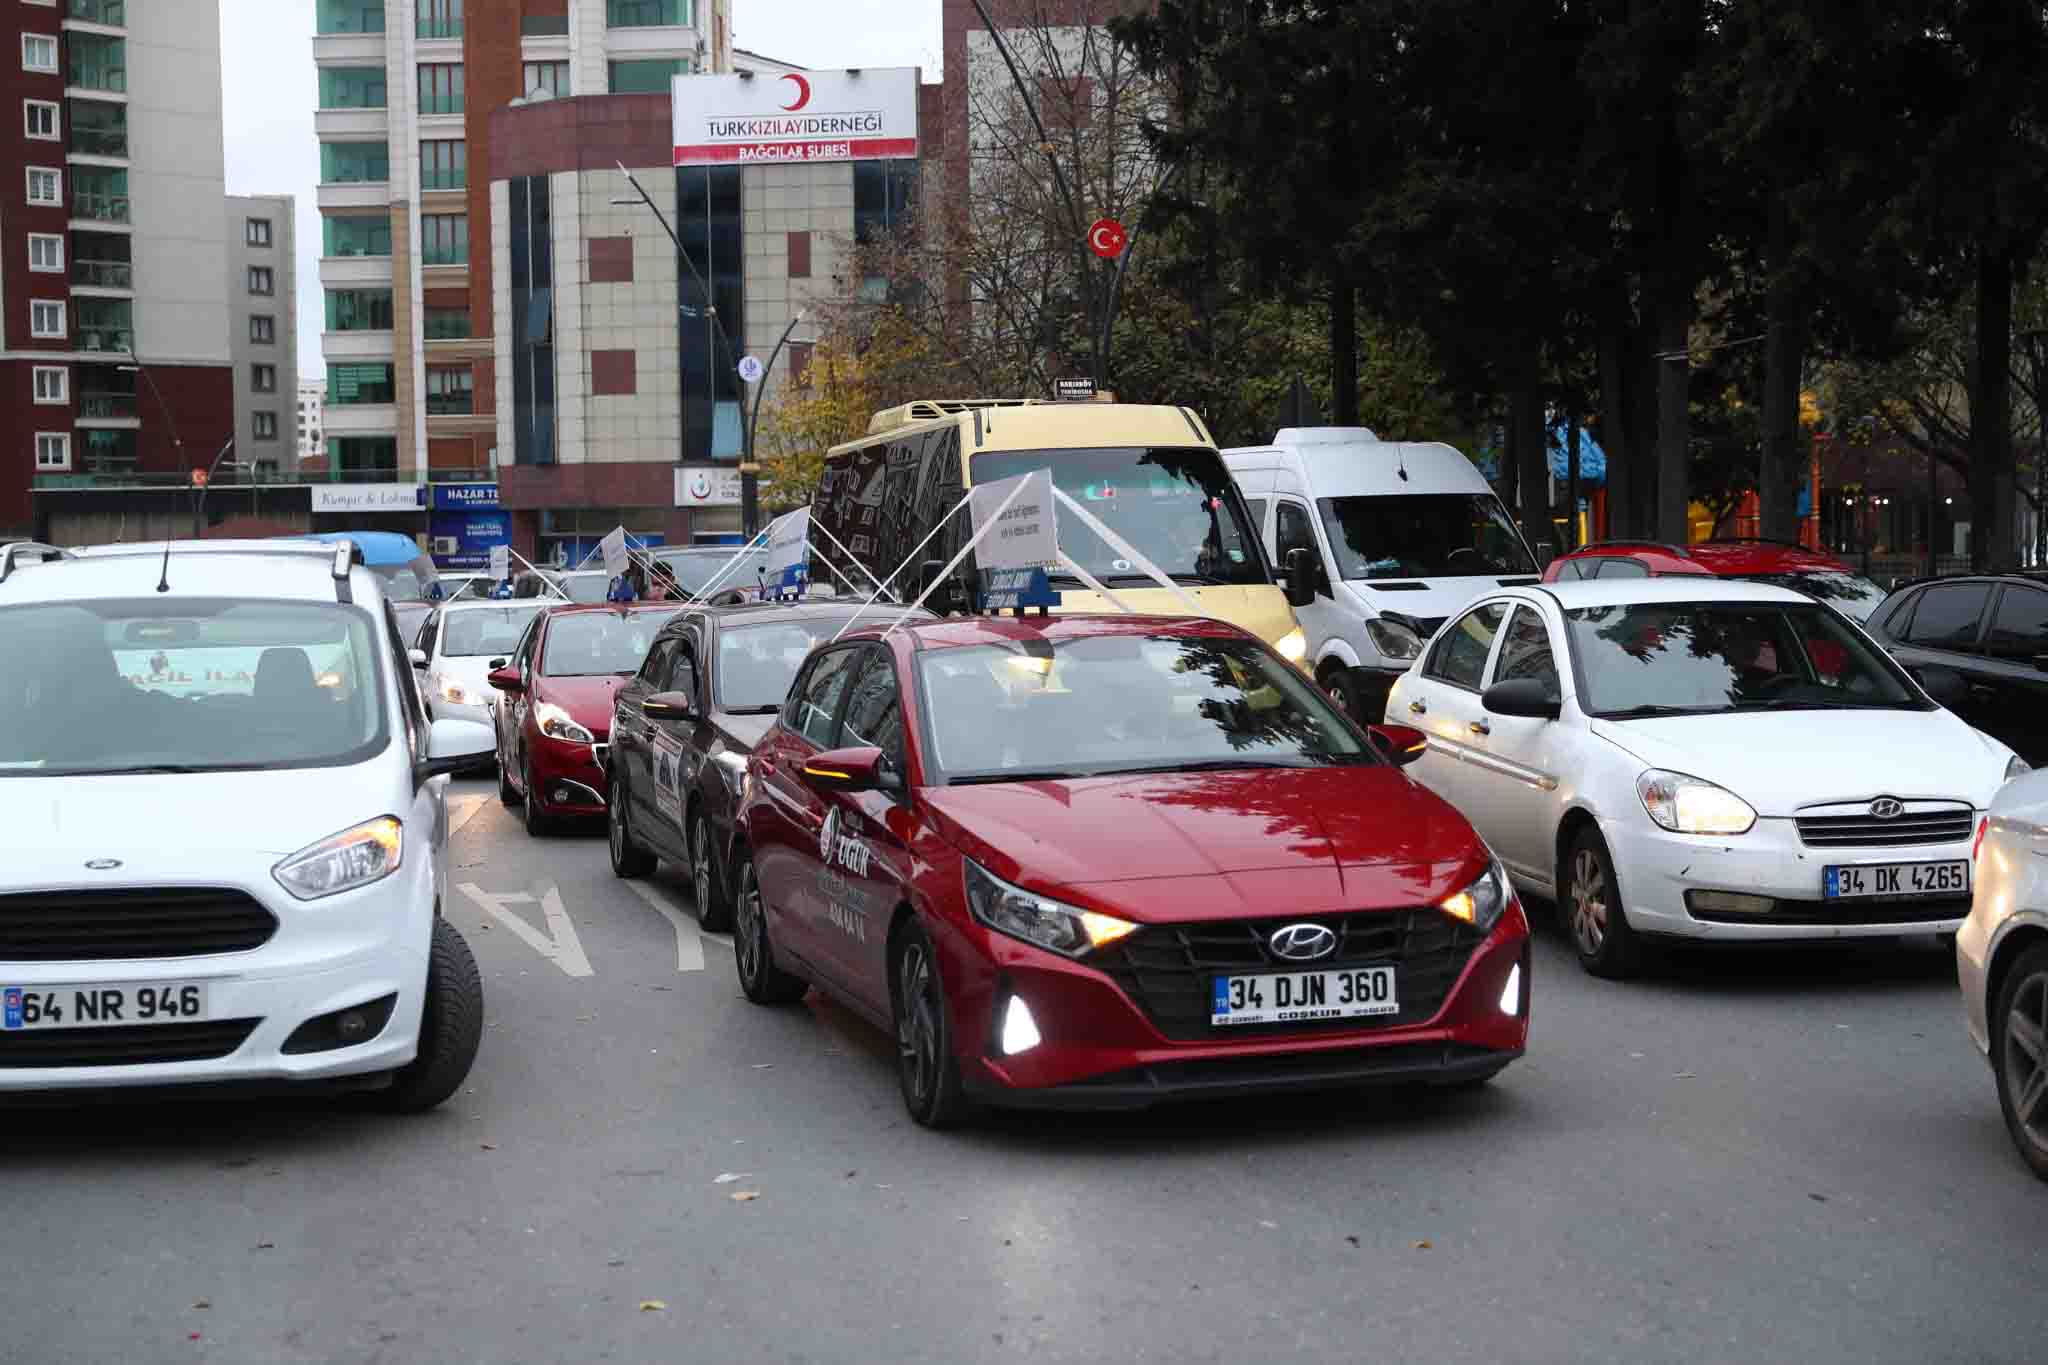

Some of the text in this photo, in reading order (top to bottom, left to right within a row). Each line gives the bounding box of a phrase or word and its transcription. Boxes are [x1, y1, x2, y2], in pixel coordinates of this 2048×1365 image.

[447, 489, 484, 499] HAZAR
[1840, 870, 1864, 893] 34
[1876, 868, 1900, 892] DK
[1912, 865, 1962, 890] 4265
[22, 992, 62, 1024] 64
[75, 989, 124, 1022] NR
[137, 985, 199, 1018] 946
[1230, 978, 1263, 1010] 34
[1275, 974, 1326, 1008] DJN
[1338, 971, 1388, 1004] 360
